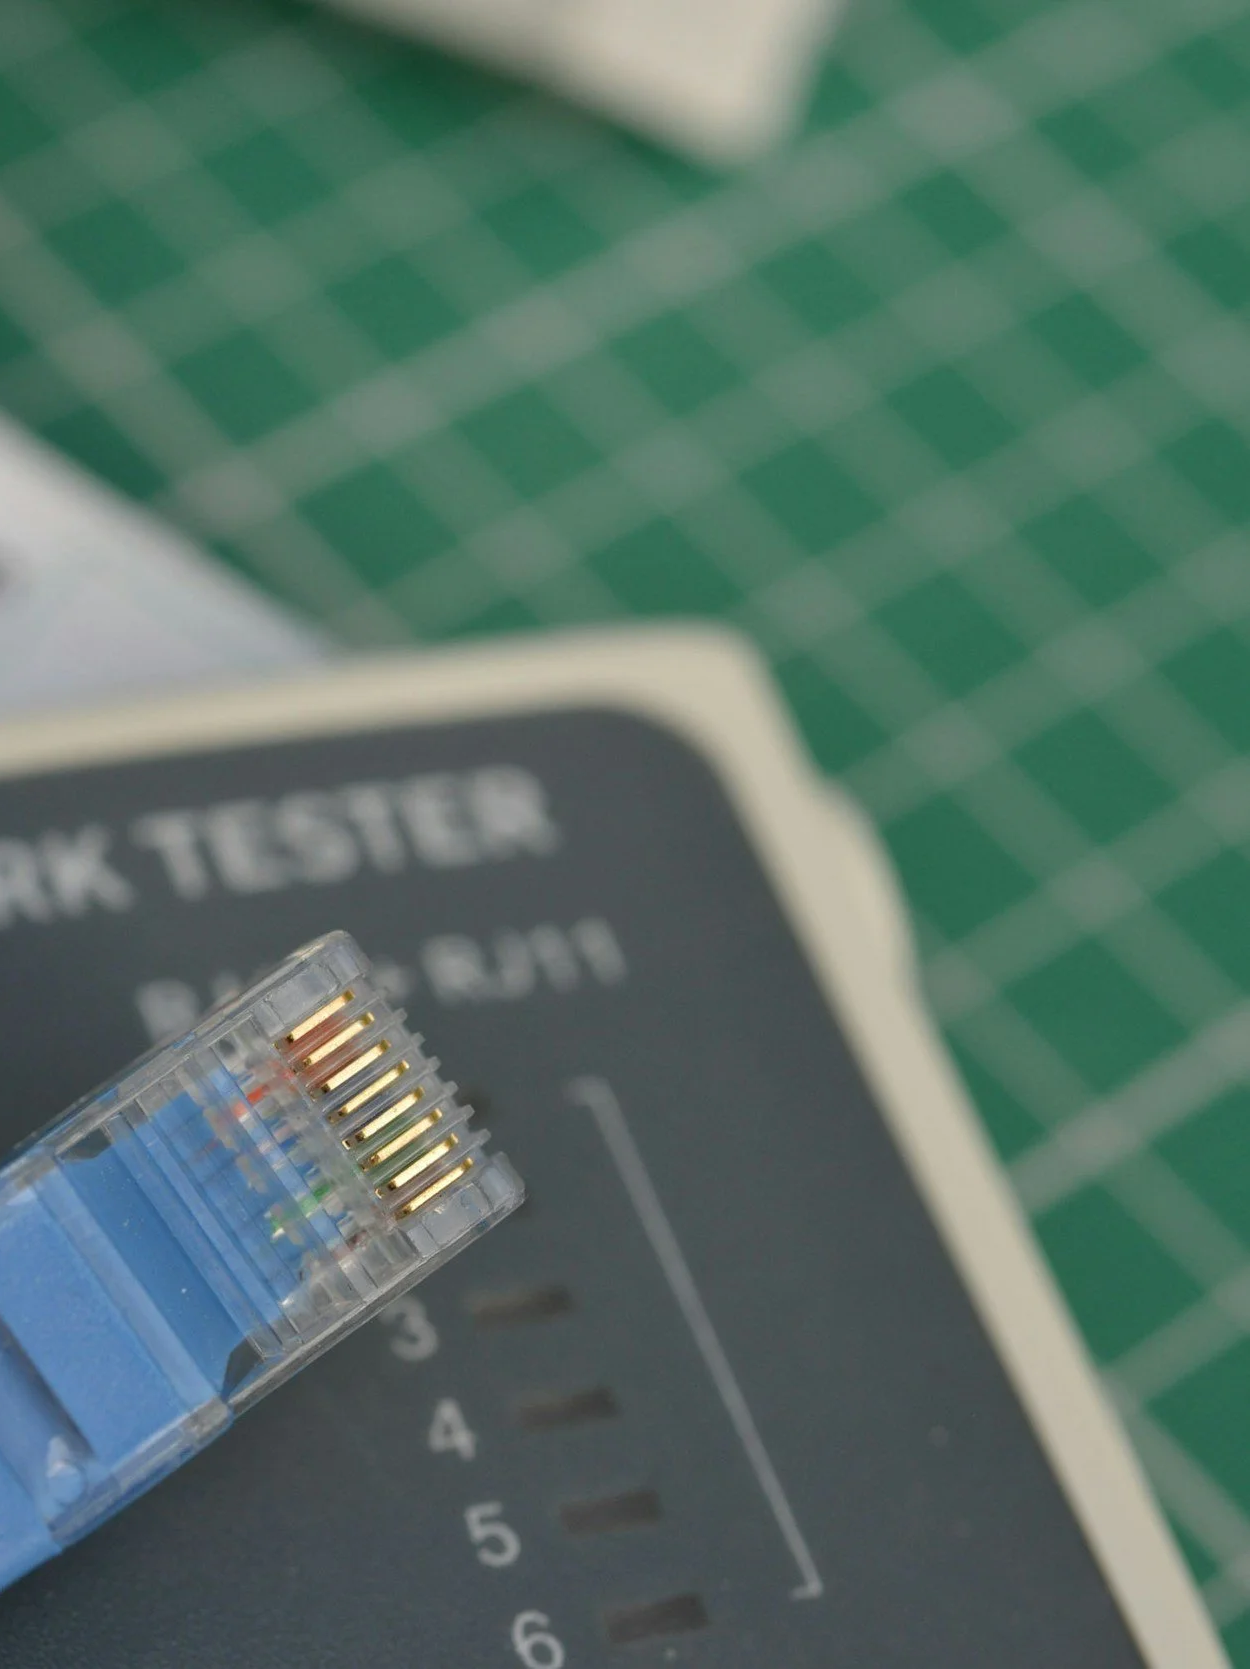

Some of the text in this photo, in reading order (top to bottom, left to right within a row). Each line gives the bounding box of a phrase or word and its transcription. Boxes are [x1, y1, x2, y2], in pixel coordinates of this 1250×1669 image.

[136, 767, 556, 899] TESTER
[422, 916, 626, 1006] RJ11
[381, 1298, 439, 1361] 3
[427, 1398, 477, 1461] 4
[464, 1501, 521, 1567] 5
[510, 1609, 564, 1669] 6
